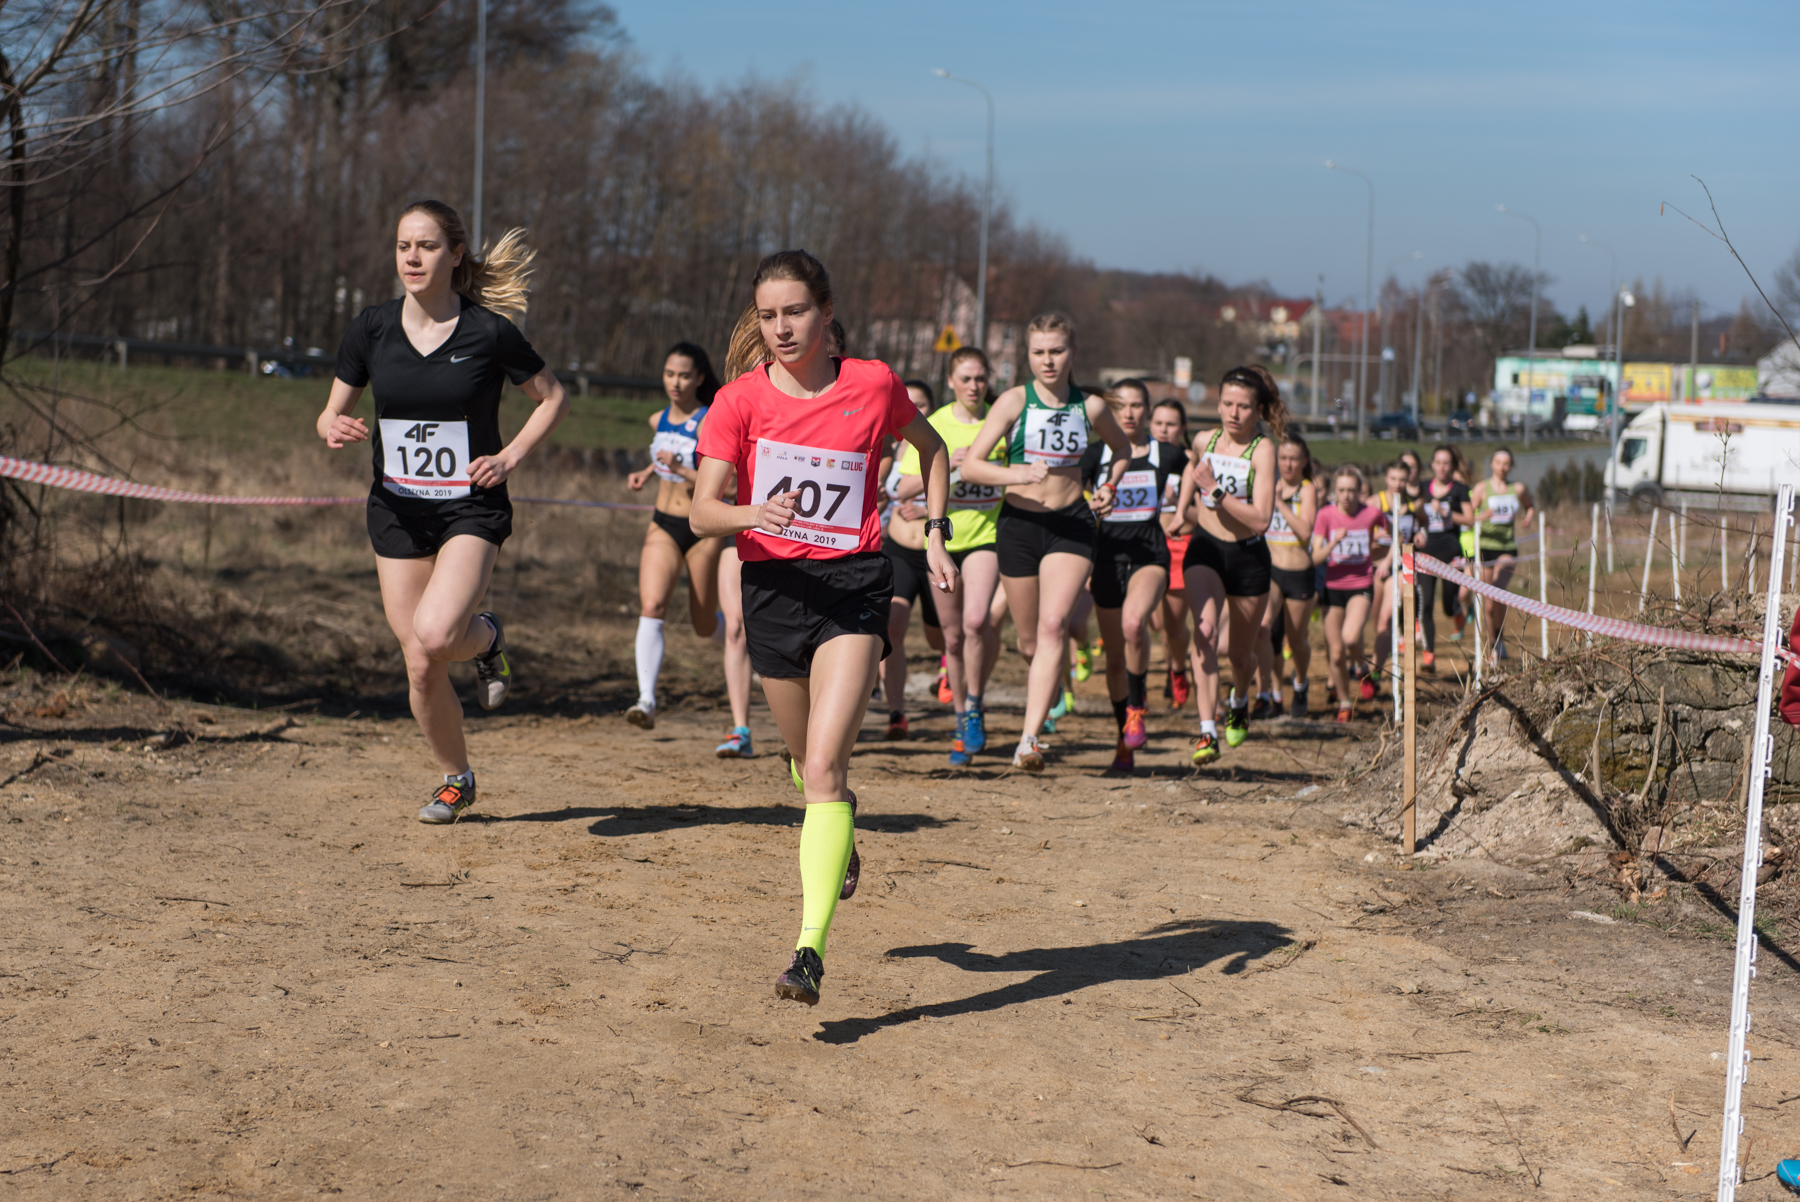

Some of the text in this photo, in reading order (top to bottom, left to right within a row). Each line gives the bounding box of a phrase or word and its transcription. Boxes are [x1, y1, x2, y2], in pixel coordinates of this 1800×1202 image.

[1047, 412, 1070, 426] 4F
[404, 423, 440, 443] 4F
[1039, 429, 1079, 453] 135
[397, 446, 456, 478] 120
[850, 461, 864, 472] LUG
[398, 487, 452, 497] OLSZYNA 2019
[955, 480, 994, 498] 345
[814, 534, 837, 546] 2019
